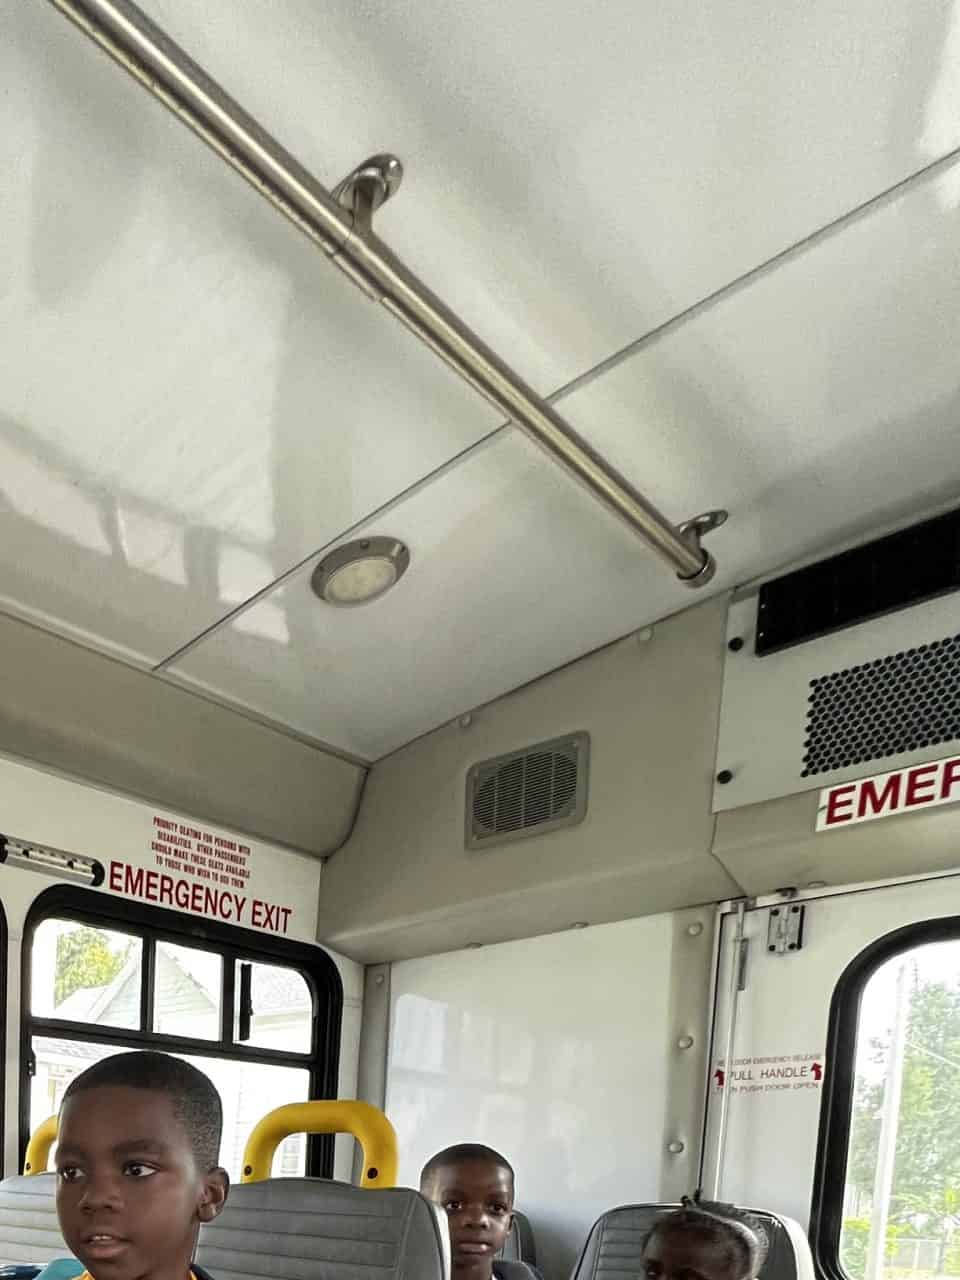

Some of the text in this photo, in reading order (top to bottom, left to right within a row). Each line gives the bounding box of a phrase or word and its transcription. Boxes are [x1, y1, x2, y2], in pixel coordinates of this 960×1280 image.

[109, 861, 292, 933] EMERGENCY EXIT
[760, 1066, 808, 1078] HANDLE
